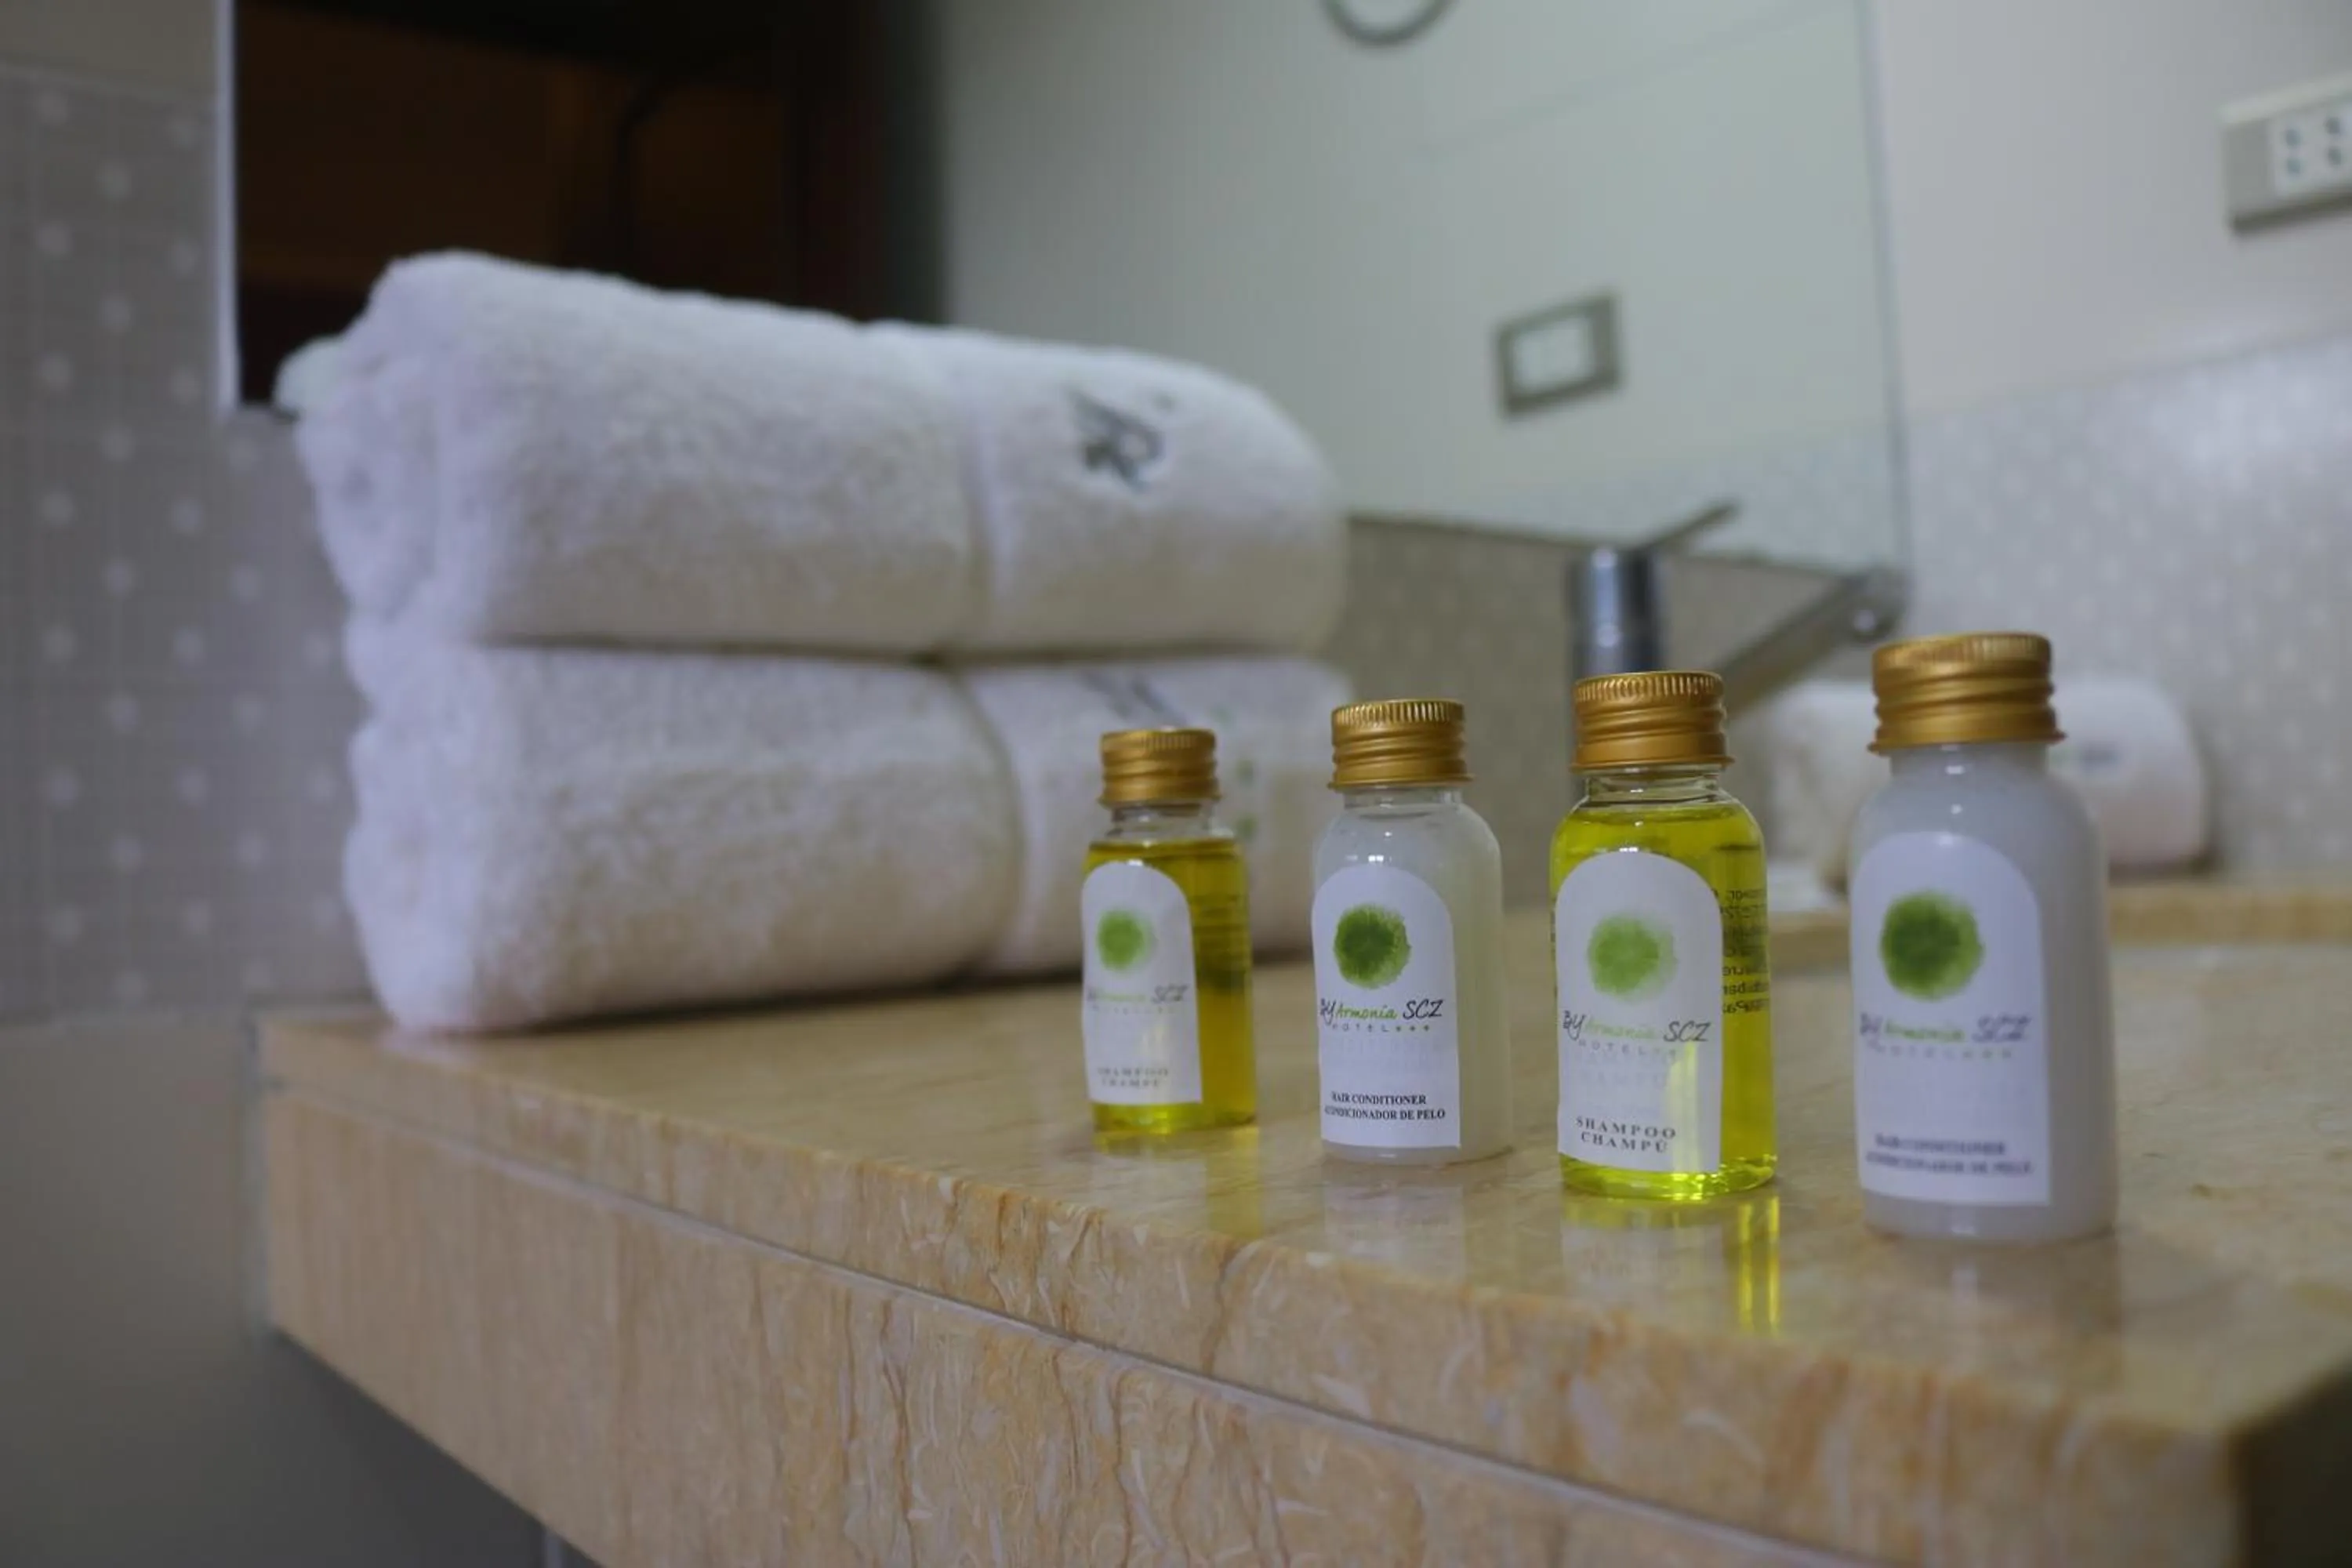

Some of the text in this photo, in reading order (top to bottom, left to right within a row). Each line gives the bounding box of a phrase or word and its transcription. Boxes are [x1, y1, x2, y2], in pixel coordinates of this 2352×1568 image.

[1403, 998, 1443, 1020] SCZ
[1664, 1021, 1711, 1043] SCZ
[1351, 1094, 1426, 1105] CONDITIONER
[1399, 1109, 1414, 1120] DE
[1417, 1108, 1446, 1120] PELO
[1575, 1116, 1676, 1141] SHAMPOO
